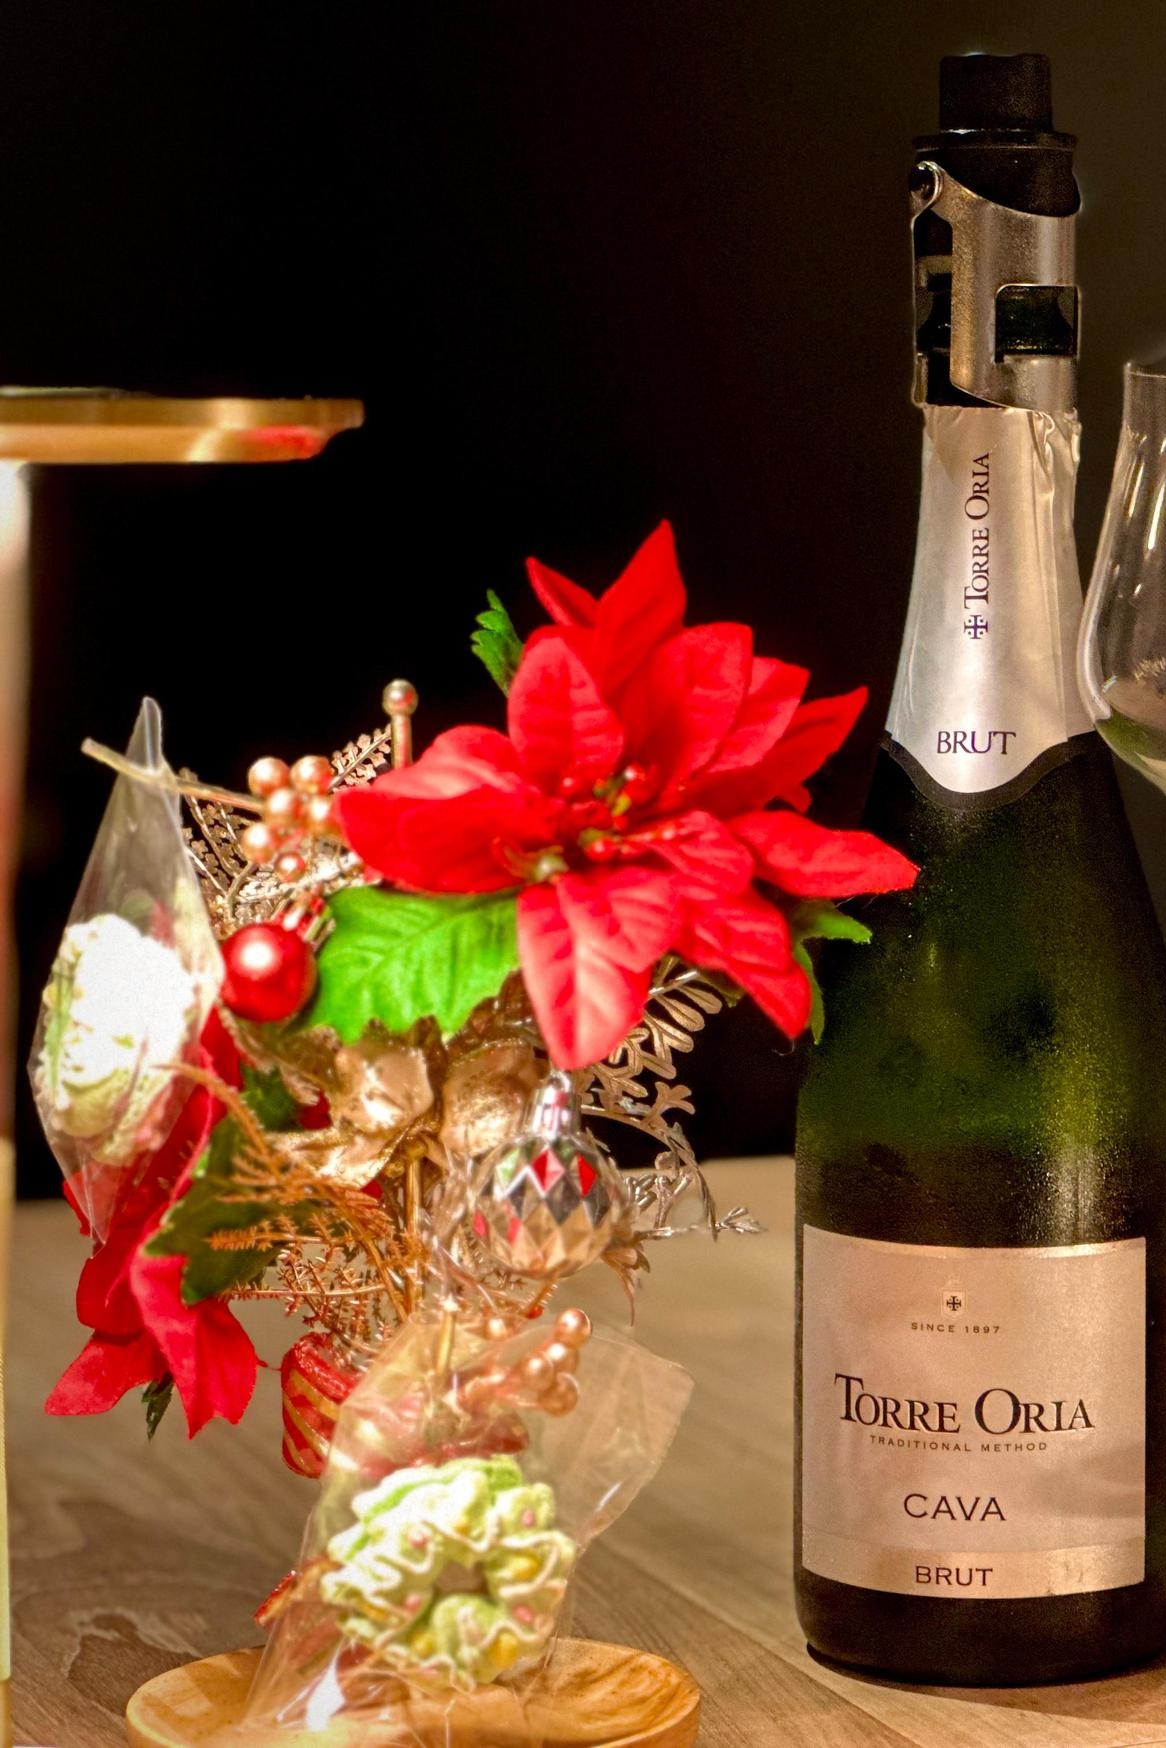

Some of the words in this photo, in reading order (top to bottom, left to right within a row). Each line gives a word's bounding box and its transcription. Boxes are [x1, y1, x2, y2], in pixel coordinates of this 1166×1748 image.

[965, 452, 990, 520] ORIA
[964, 527, 990, 610] TORRE
[937, 731, 1016, 755] BRUT
[911, 1322, 956, 1333] SINCE
[965, 1324, 1001, 1334] 1897
[834, 1373, 961, 1433] TORRE
[974, 1388, 1096, 1434] ORIA
[870, 1435, 971, 1452] TRADITIONAL
[981, 1442, 1048, 1452] METHOD
[904, 1494, 1006, 1521] CAVA
[915, 1566, 993, 1586] BRUT
